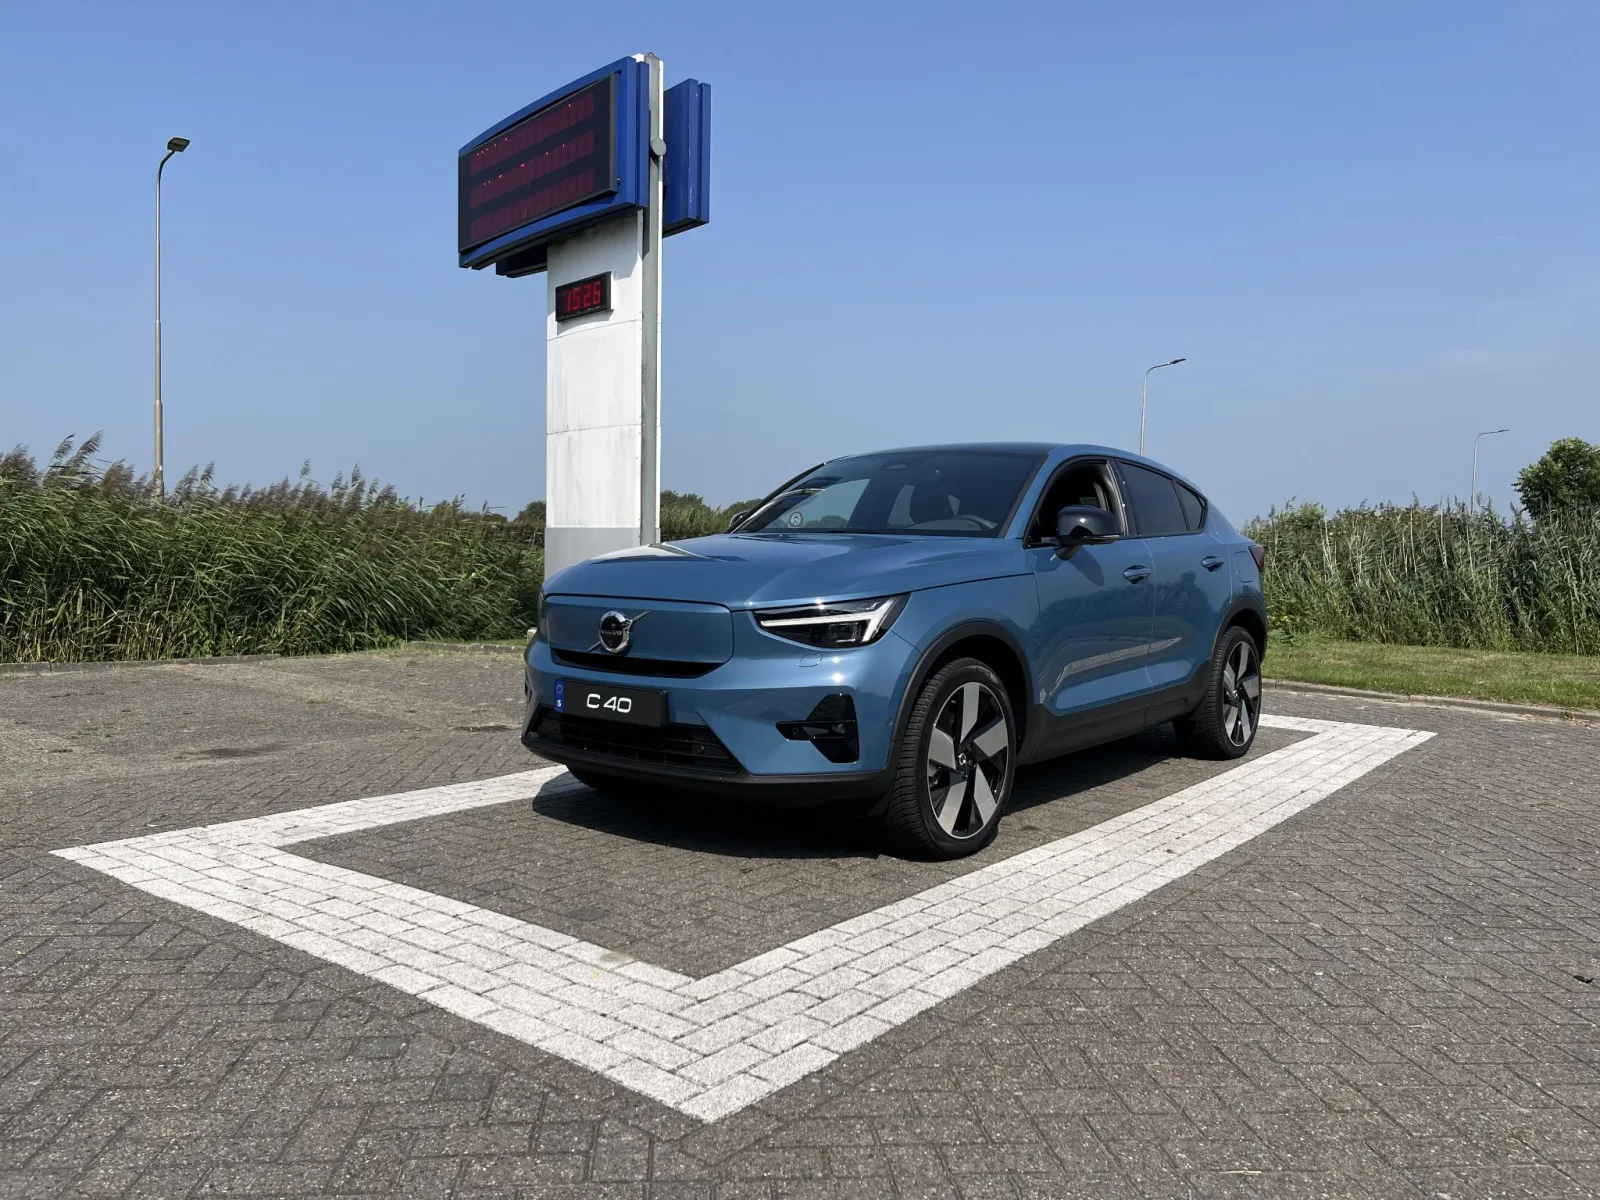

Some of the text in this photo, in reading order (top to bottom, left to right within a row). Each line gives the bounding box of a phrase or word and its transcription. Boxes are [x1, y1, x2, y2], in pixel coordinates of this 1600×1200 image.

[557, 699, 562, 707] S
[586, 693, 632, 713] C 40
